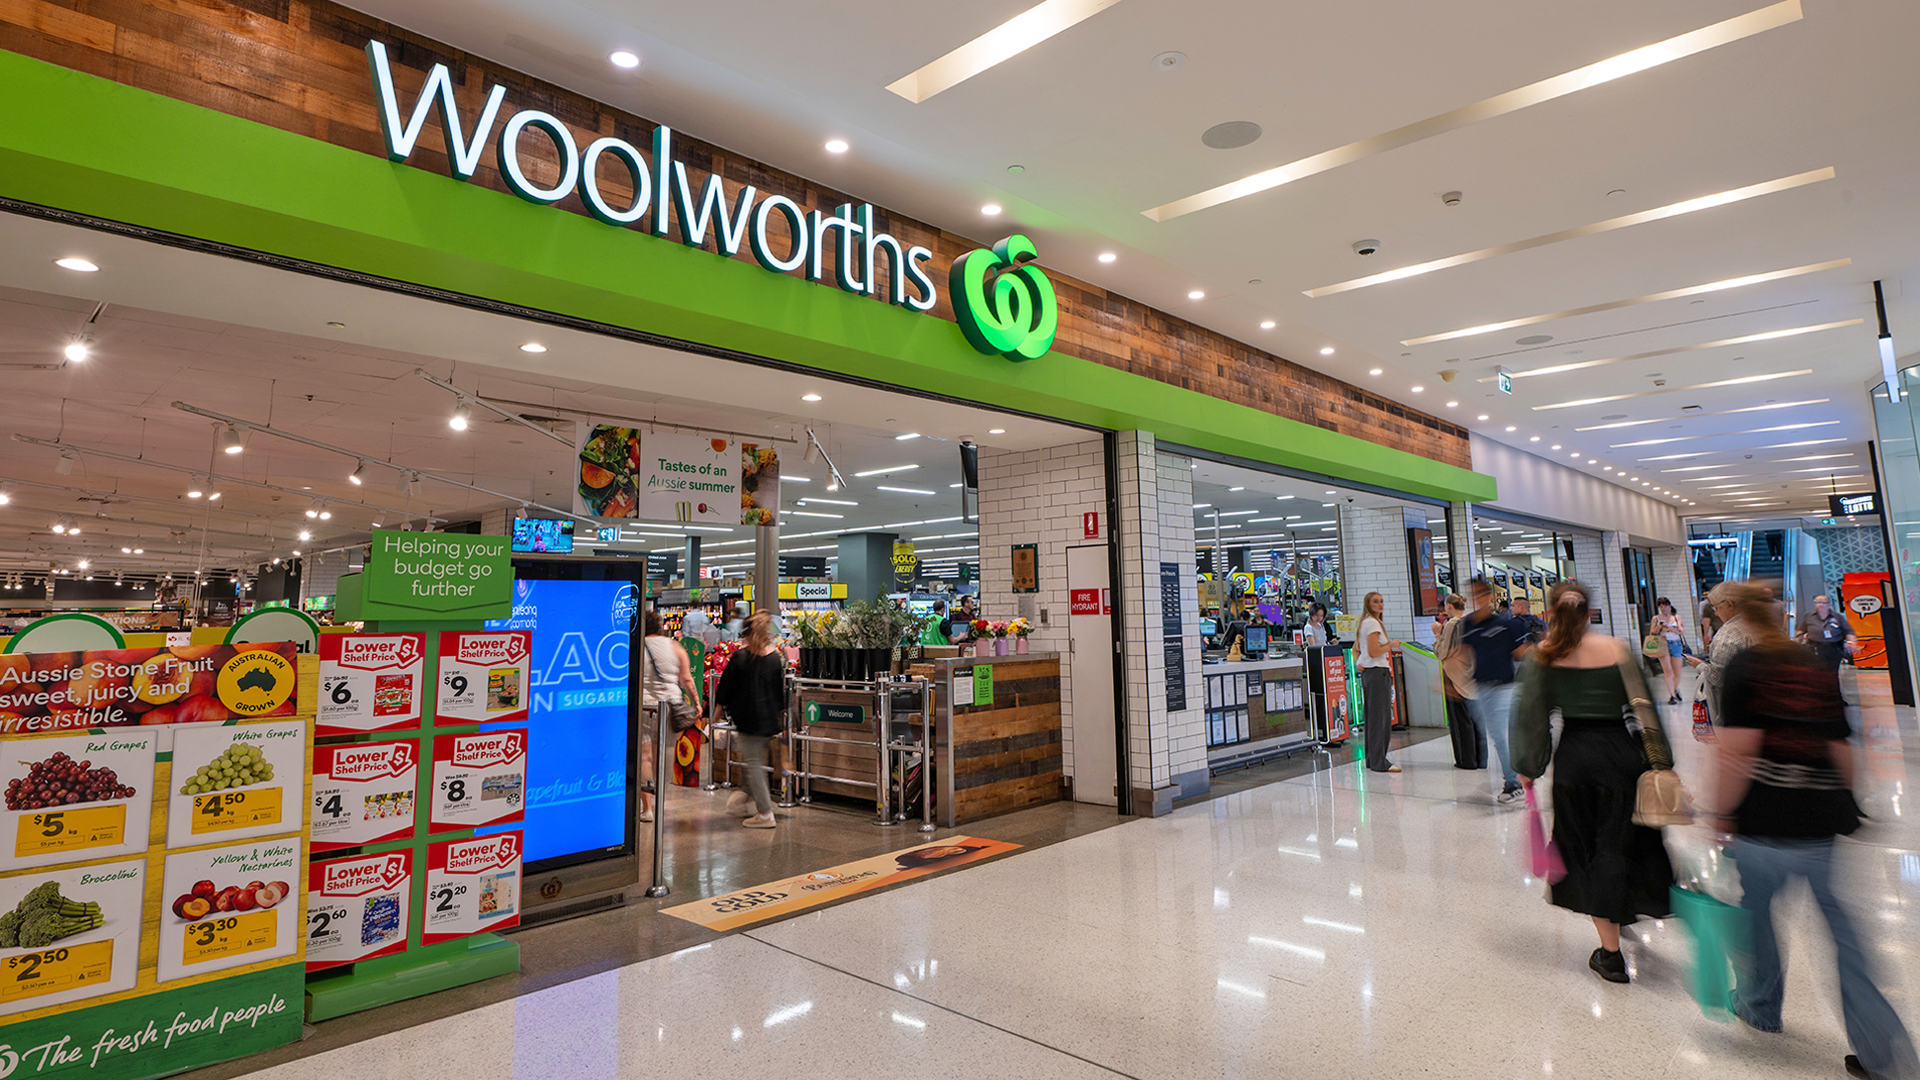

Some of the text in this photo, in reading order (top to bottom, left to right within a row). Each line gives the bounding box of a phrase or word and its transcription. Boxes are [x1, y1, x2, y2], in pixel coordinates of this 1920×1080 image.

[365, 39, 938, 312] Woolworths
[658, 459, 727, 476] Tastes of an
[647, 474, 736, 493] Aussie summer
[1848, 502, 1874, 514] LOTTO
[385, 536, 504, 560] Helping your
[893, 555, 917, 564] SOLO
[394, 558, 492, 580] budget go
[411, 579, 475, 596] further
[800, 587, 828, 597] Special
[1078, 593, 1091, 602] FIRE
[1072, 602, 1098, 611] HYDRANT
[344, 640, 396, 653] Lower
[461, 637, 505, 650] Lower
[344, 653, 395, 662] Shelf Price
[460, 649, 506, 658] Shelf Price
[229, 653, 285, 672] AUSTRALIAN
[0, 656, 214, 685] Aussie Stone Fruit
[0, 677, 190, 708] sweet, juicy and
[324, 681, 352, 705] $6
[444, 675, 468, 697] $9
[235, 699, 275, 712] GROWN
[0, 705, 128, 732] irresistible.
[828, 709, 854, 718] Welcome
[233, 729, 298, 741] White Grapes
[85, 741, 148, 753] Red Grapes
[456, 740, 502, 753] Lower
[336, 751, 389, 765] Lower
[456, 751, 502, 761] Shelf Price
[335, 763, 388, 775] Shelf Price
[440, 780, 465, 802] $8
[315, 794, 343, 818] $4
[34, 812, 64, 837] $5
[211, 846, 293, 868] Yellow & White
[450, 844, 496, 859] Lower
[238, 858, 293, 873] Nectarines
[449, 855, 496, 868] Shelf Price
[80, 868, 138, 885] Broccolini
[328, 864, 382, 882] Lower
[326, 877, 381, 891] Shelf Price
[711, 891, 766, 907] OLD
[716, 892, 788, 913] GOLD
[21, 993, 287, 1072] The fresh food people
